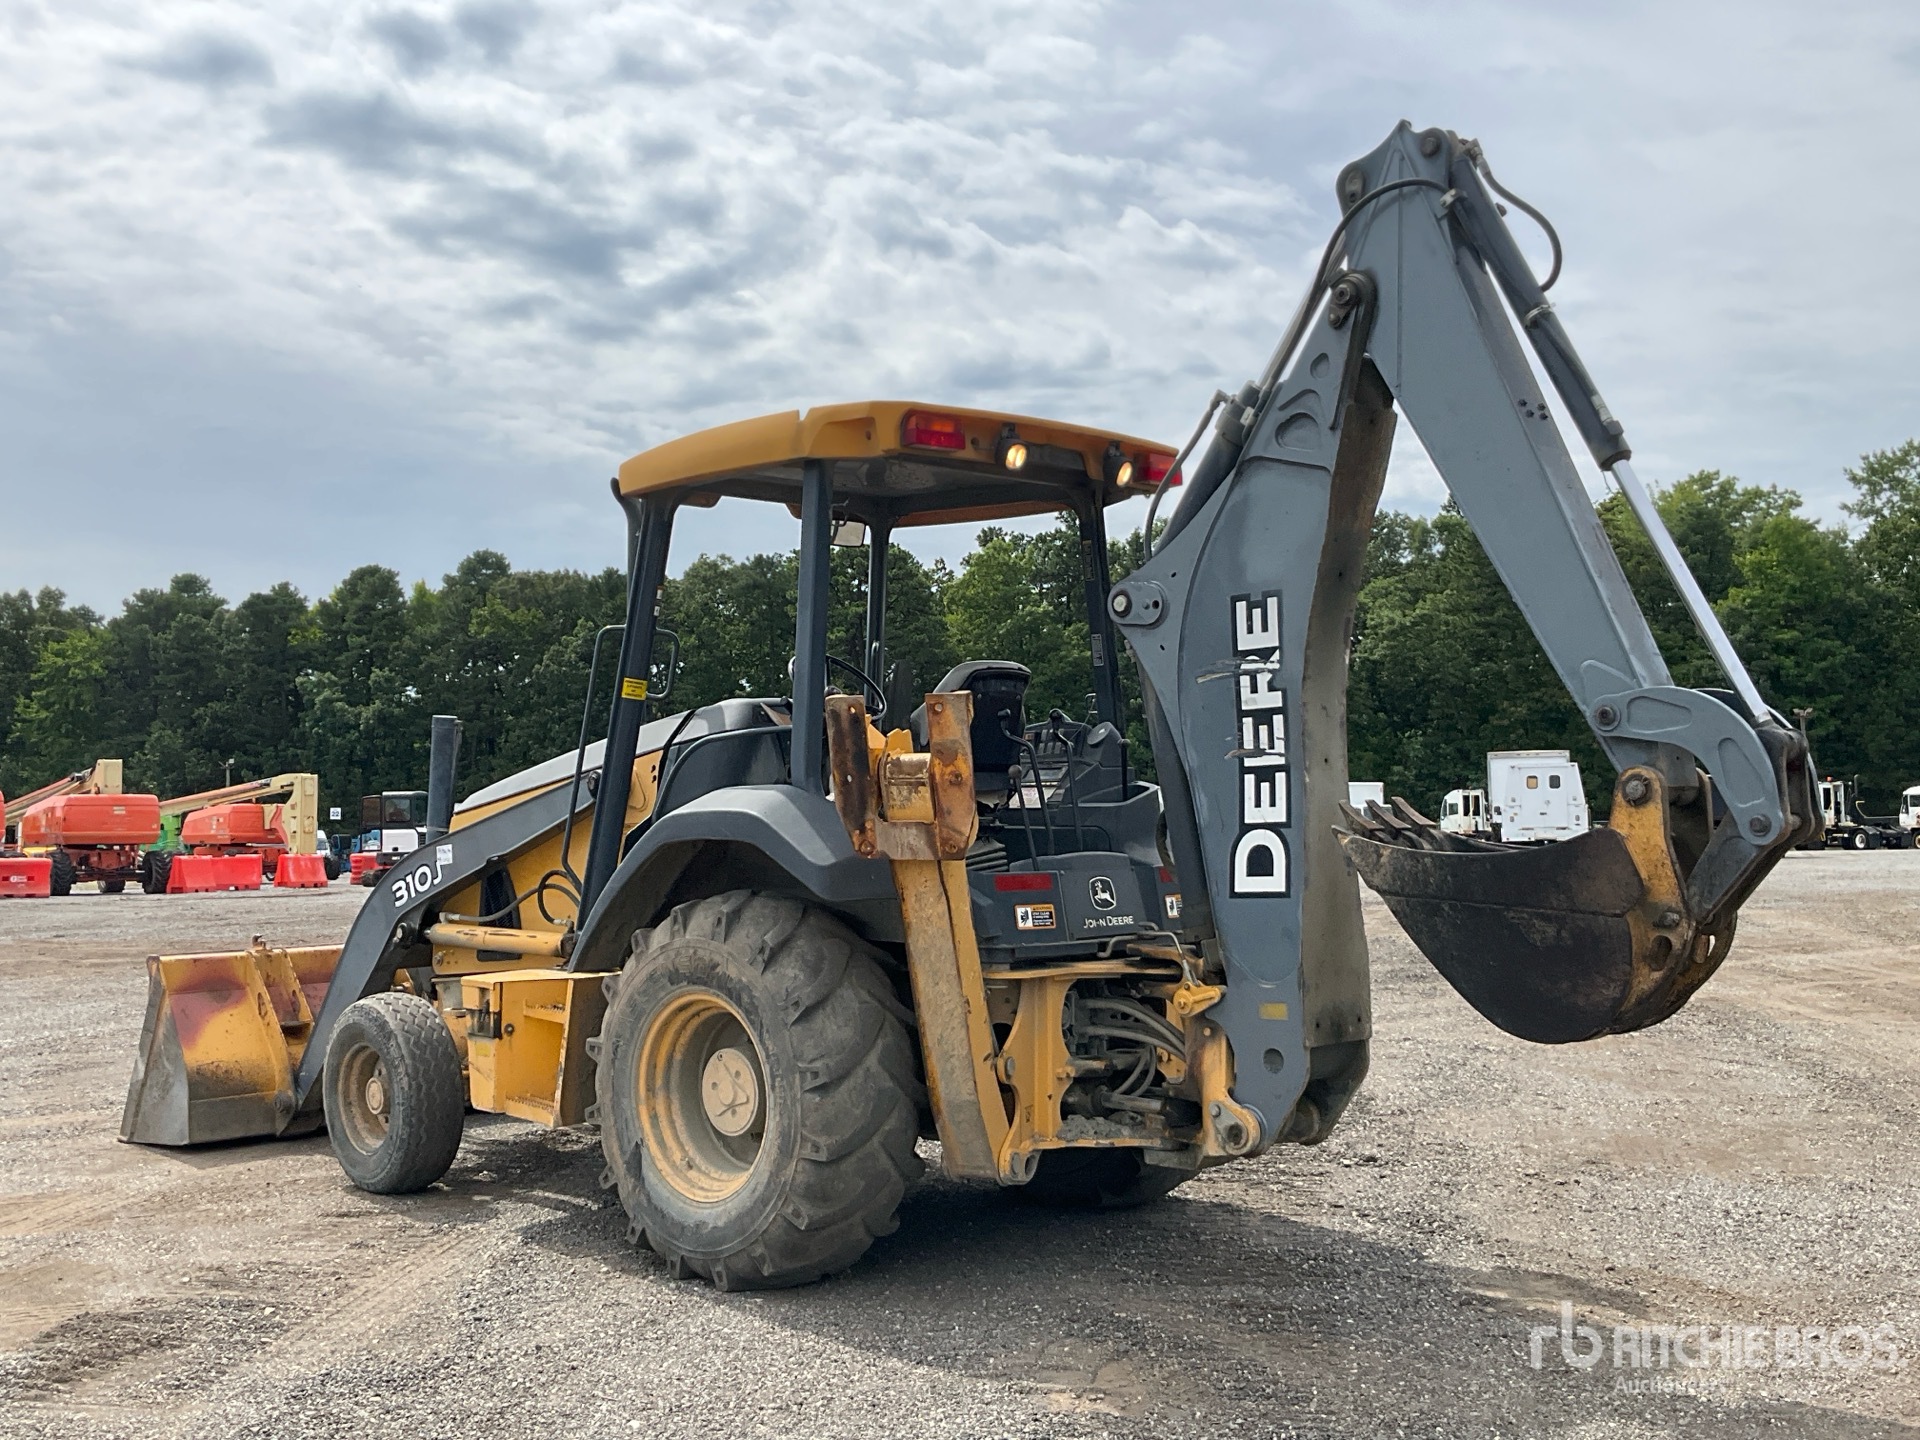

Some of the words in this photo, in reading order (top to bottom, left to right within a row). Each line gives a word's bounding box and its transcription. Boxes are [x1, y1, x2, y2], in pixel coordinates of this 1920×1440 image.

[1233, 595, 1288, 894] DEERE
[391, 860, 443, 908] 310J
[1083, 917, 1106, 929] JOHN
[1106, 915, 1134, 927] DEERE
